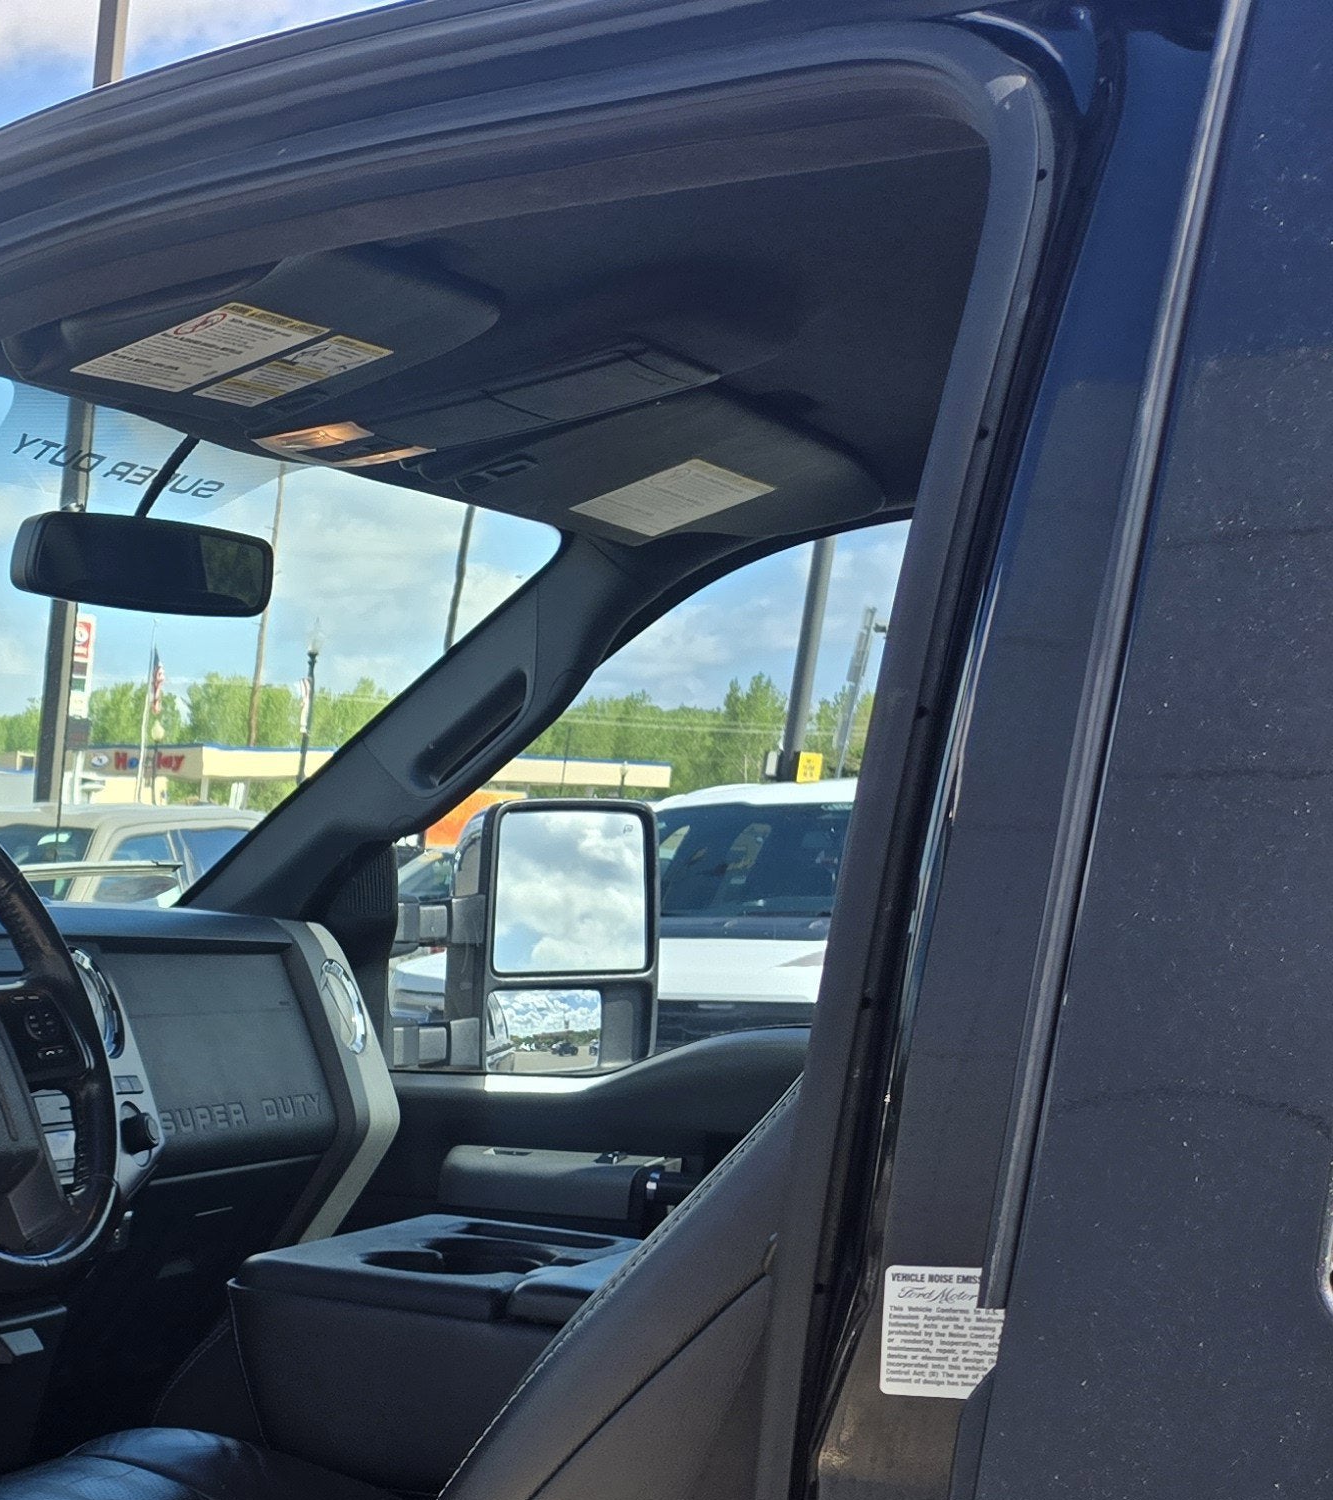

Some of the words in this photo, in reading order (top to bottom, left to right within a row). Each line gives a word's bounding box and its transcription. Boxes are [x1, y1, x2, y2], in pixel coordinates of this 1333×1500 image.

[160, 1102, 248, 1136] SUPER
[260, 1094, 323, 1122] DUTY
[891, 1273, 925, 1283] VEHICLE
[928, 1274, 953, 1284] NOISE
[898, 1286, 936, 1301] Ford
[930, 1287, 979, 1305] Motor
